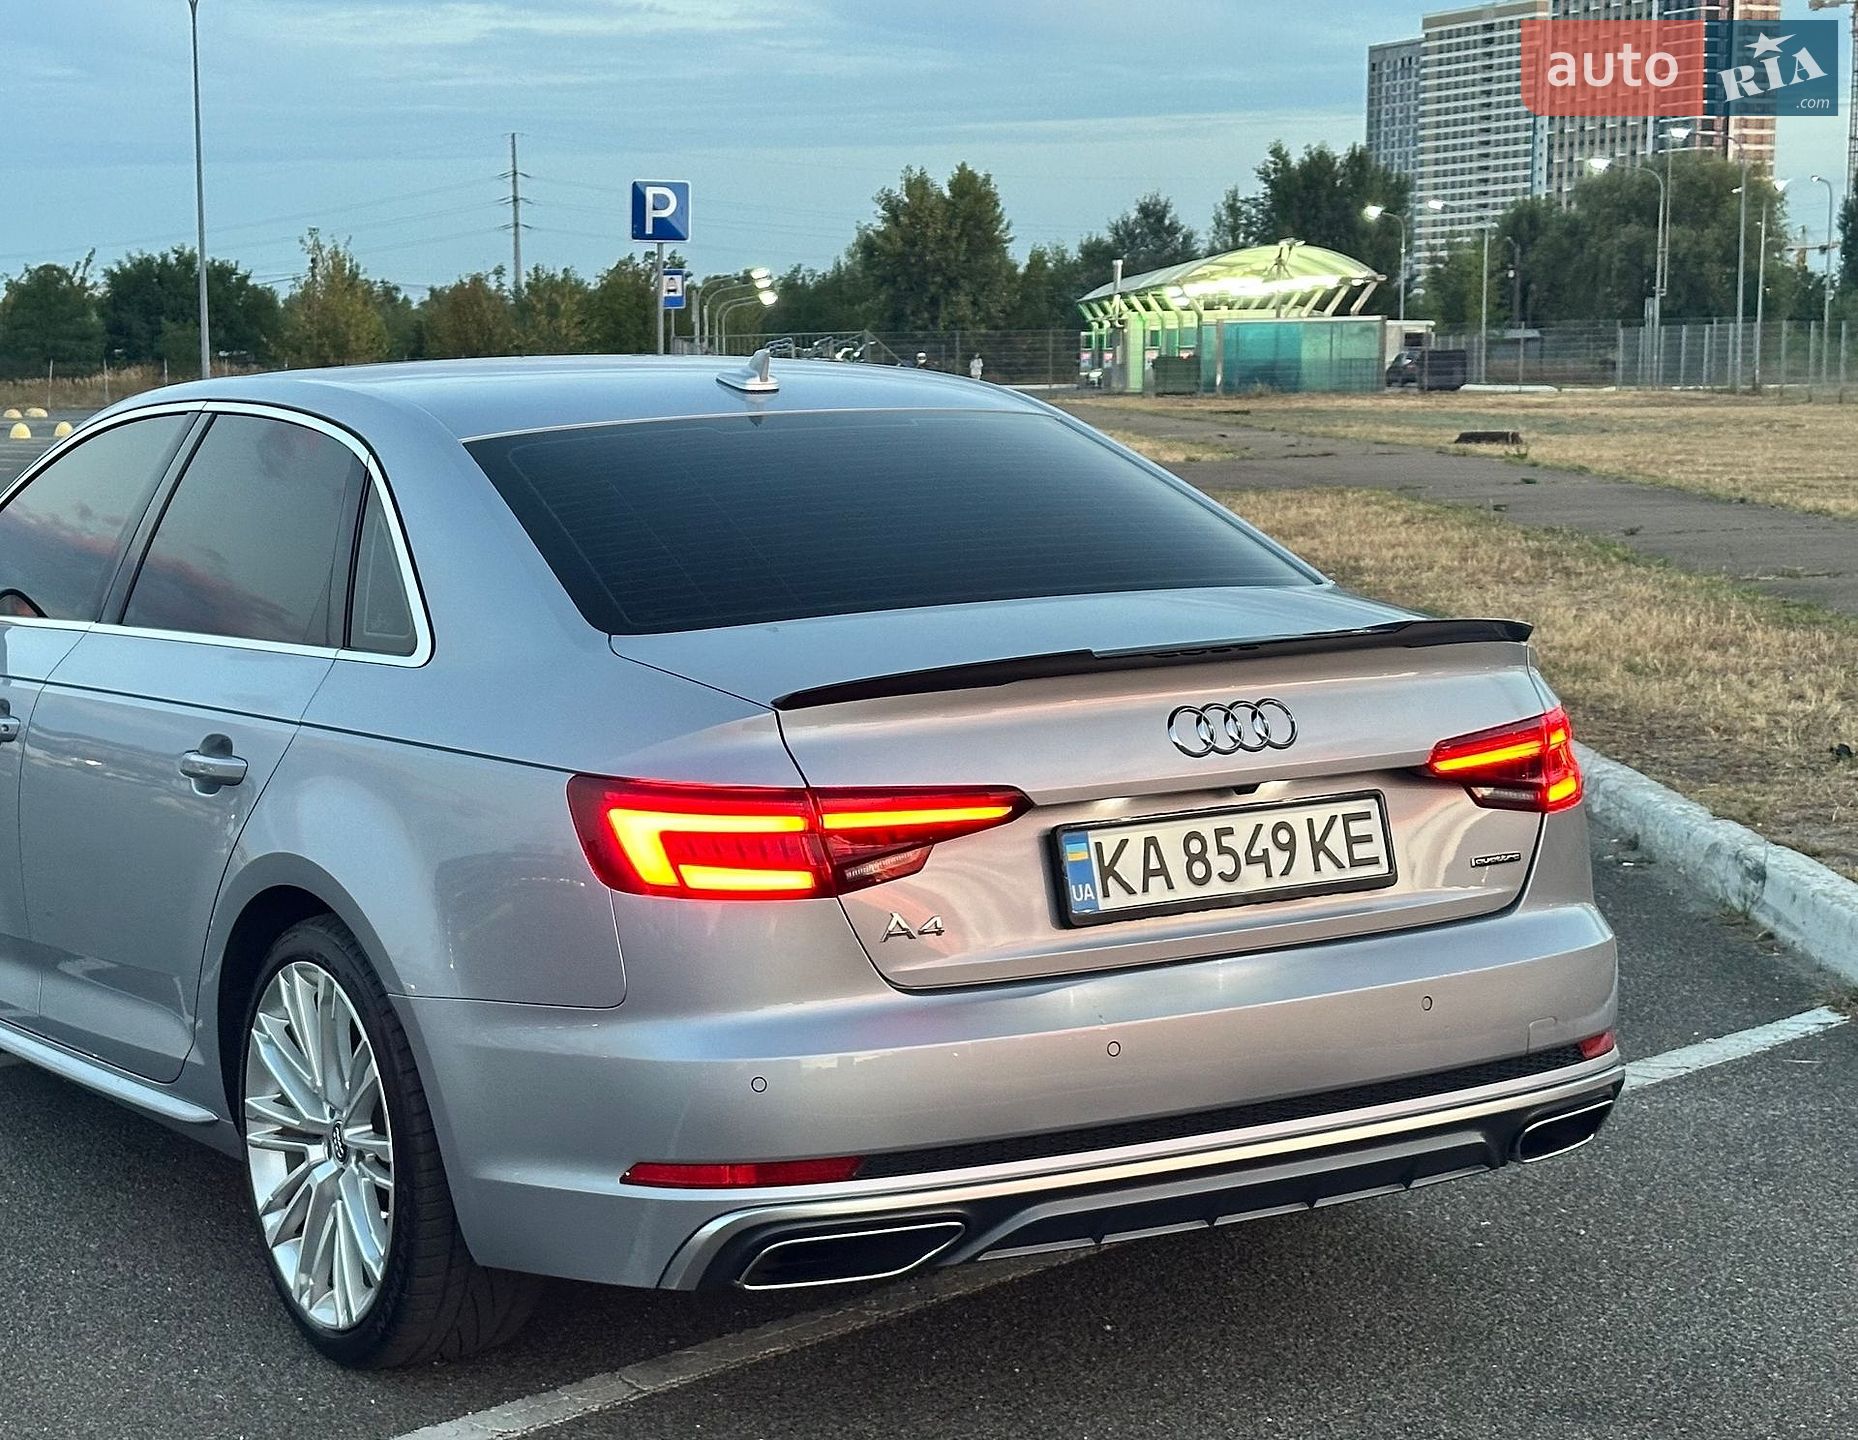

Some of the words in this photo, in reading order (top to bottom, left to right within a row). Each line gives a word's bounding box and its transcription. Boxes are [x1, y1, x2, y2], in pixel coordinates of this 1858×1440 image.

[645, 186, 677, 234] P
[1094, 836, 1176, 898] KA
[1182, 821, 1297, 886] 8549
[1307, 811, 1381, 872] KE
[1072, 883, 1095, 902] UA
[880, 912, 945, 943] A4
